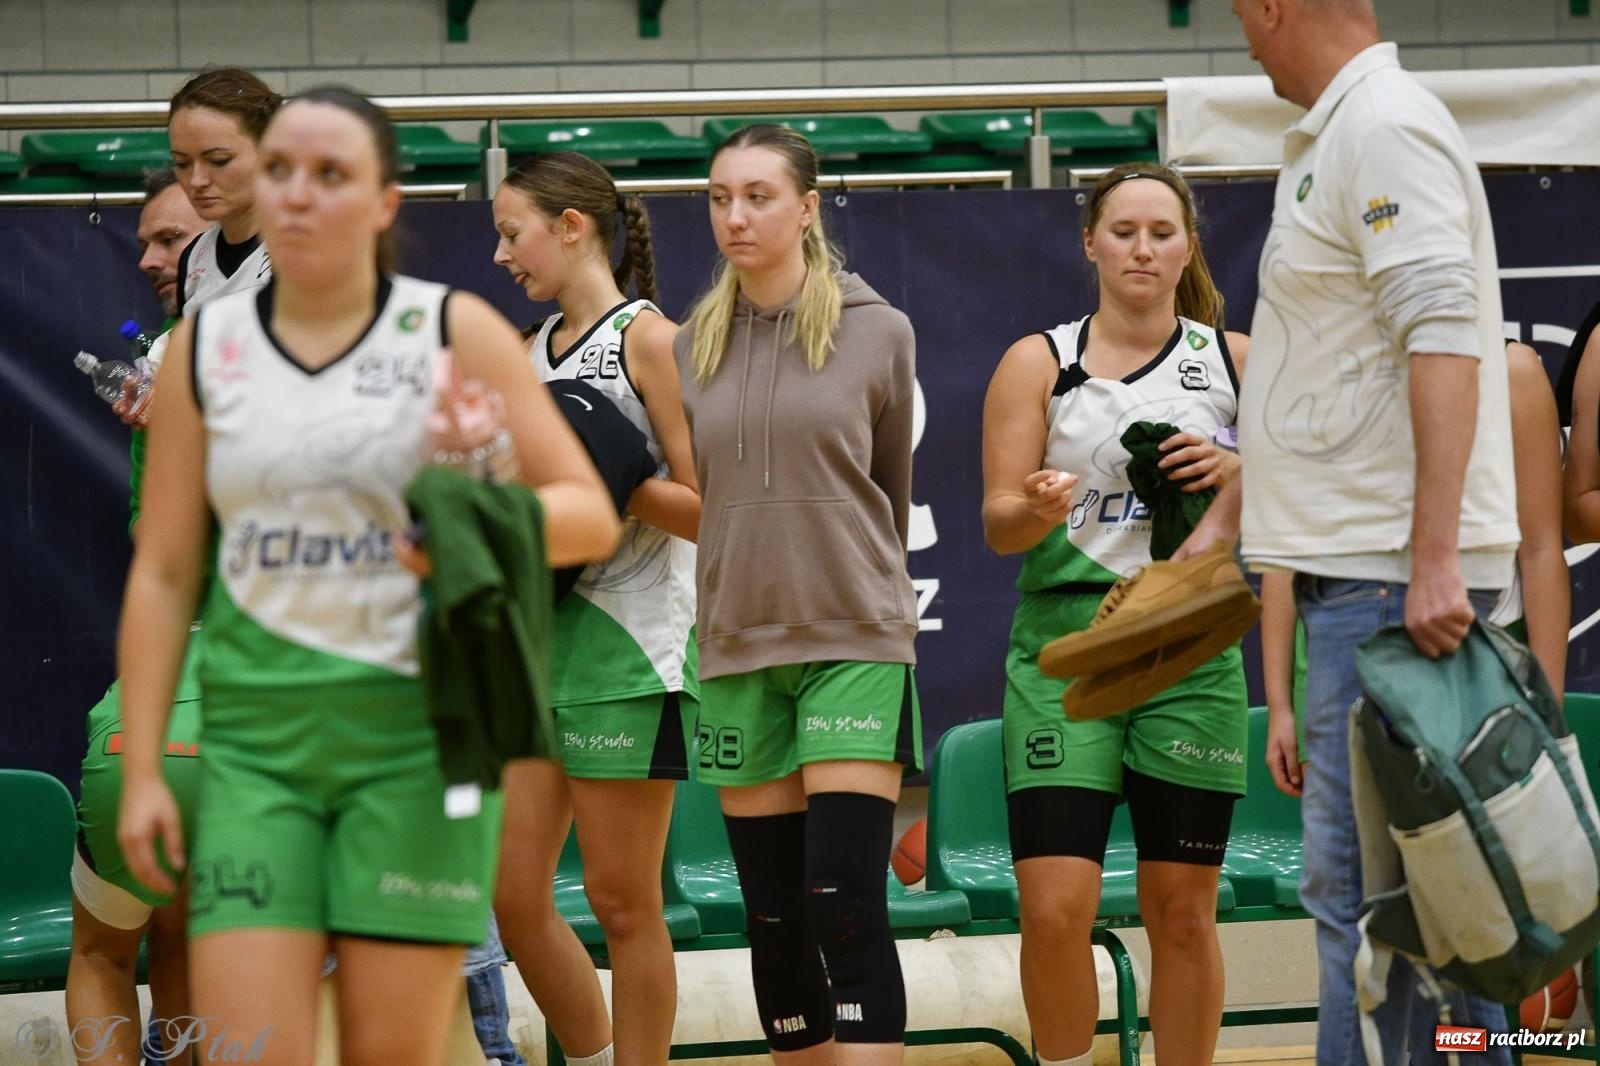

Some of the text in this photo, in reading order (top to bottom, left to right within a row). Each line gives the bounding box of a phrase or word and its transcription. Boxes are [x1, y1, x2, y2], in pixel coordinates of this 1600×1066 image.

[576, 343, 620, 380] 26
[1178, 359, 1211, 391] 3
[1098, 490, 1152, 523] Cla
[699, 723, 745, 770] 28
[1026, 728, 1065, 770] 3
[782, 1014, 807, 1034] NBA
[842, 1003, 863, 1022] NBA
